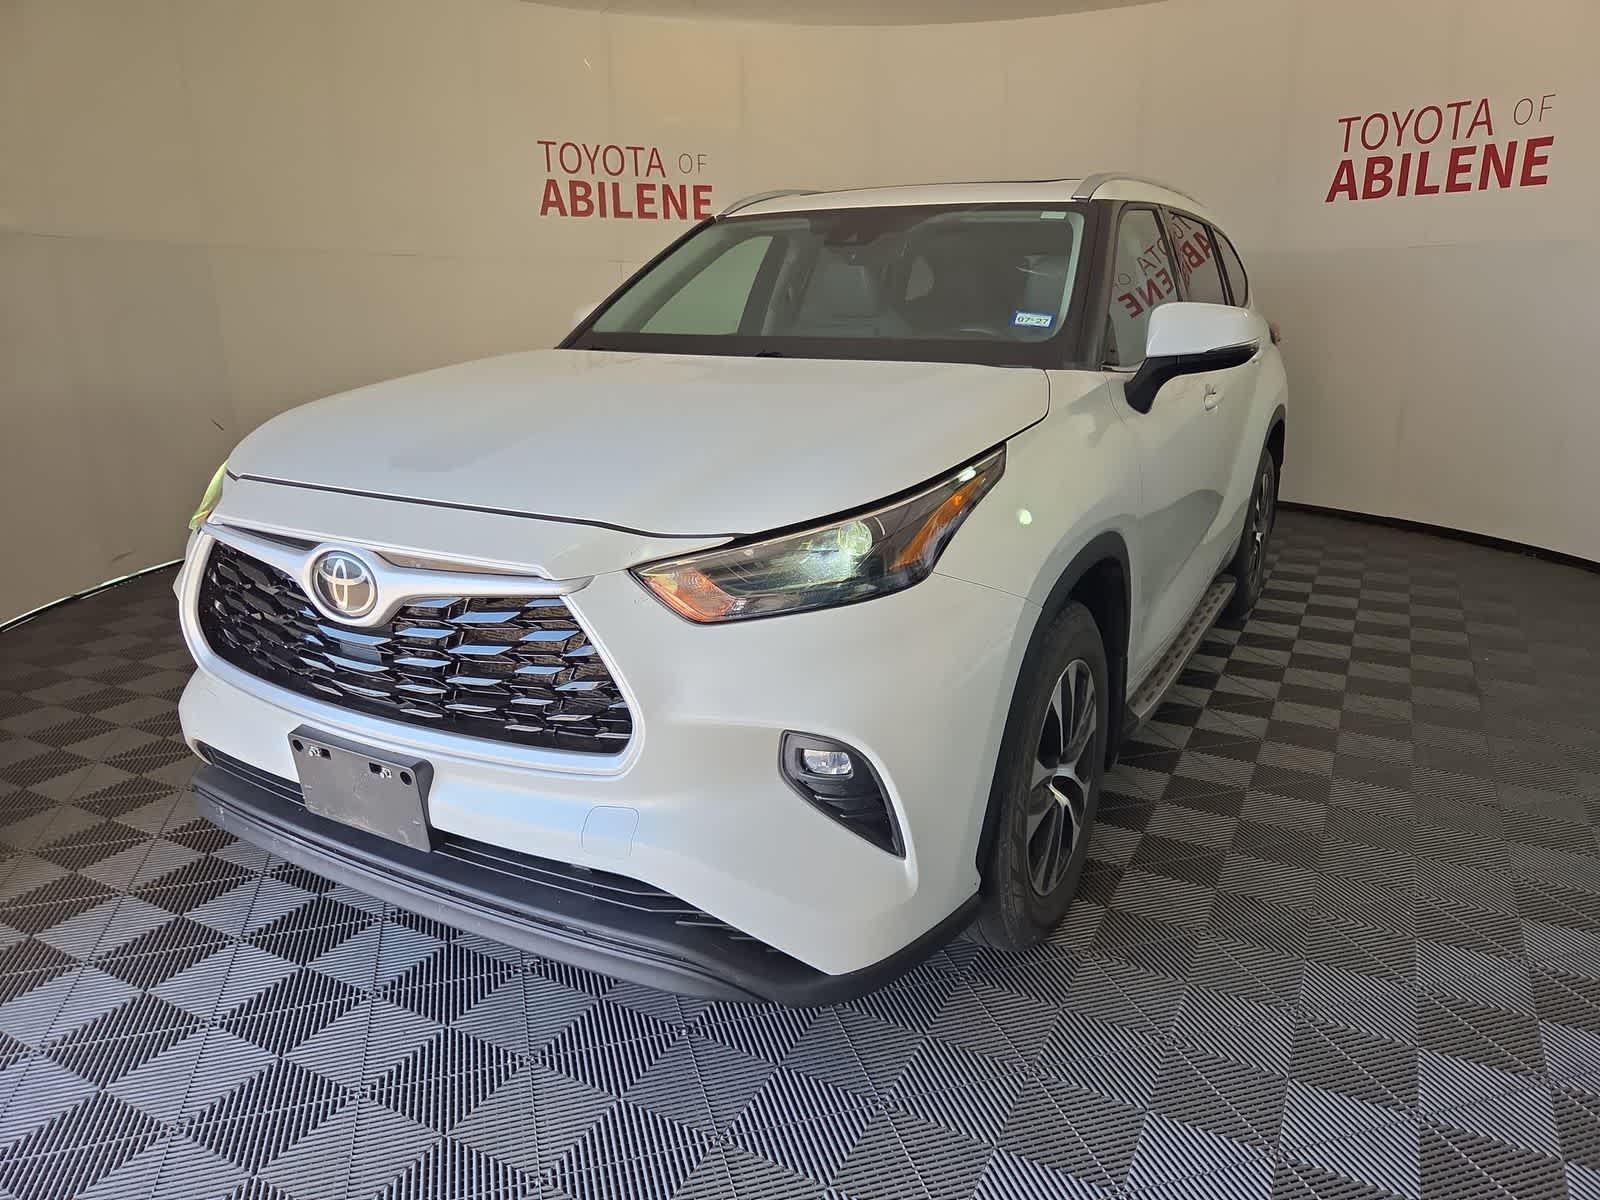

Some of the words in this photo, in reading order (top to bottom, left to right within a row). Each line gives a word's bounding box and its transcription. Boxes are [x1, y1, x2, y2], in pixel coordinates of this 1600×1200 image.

[1338, 98, 1494, 152] TOYOTA
[1513, 94, 1556, 126] OF
[537, 140, 666, 178] TOYOTA
[678, 153, 707, 174] OF
[1325, 136, 1554, 203] ABILENE
[540, 178, 713, 220] ABILENE
[1017, 315, 1049, 325] 07-27
